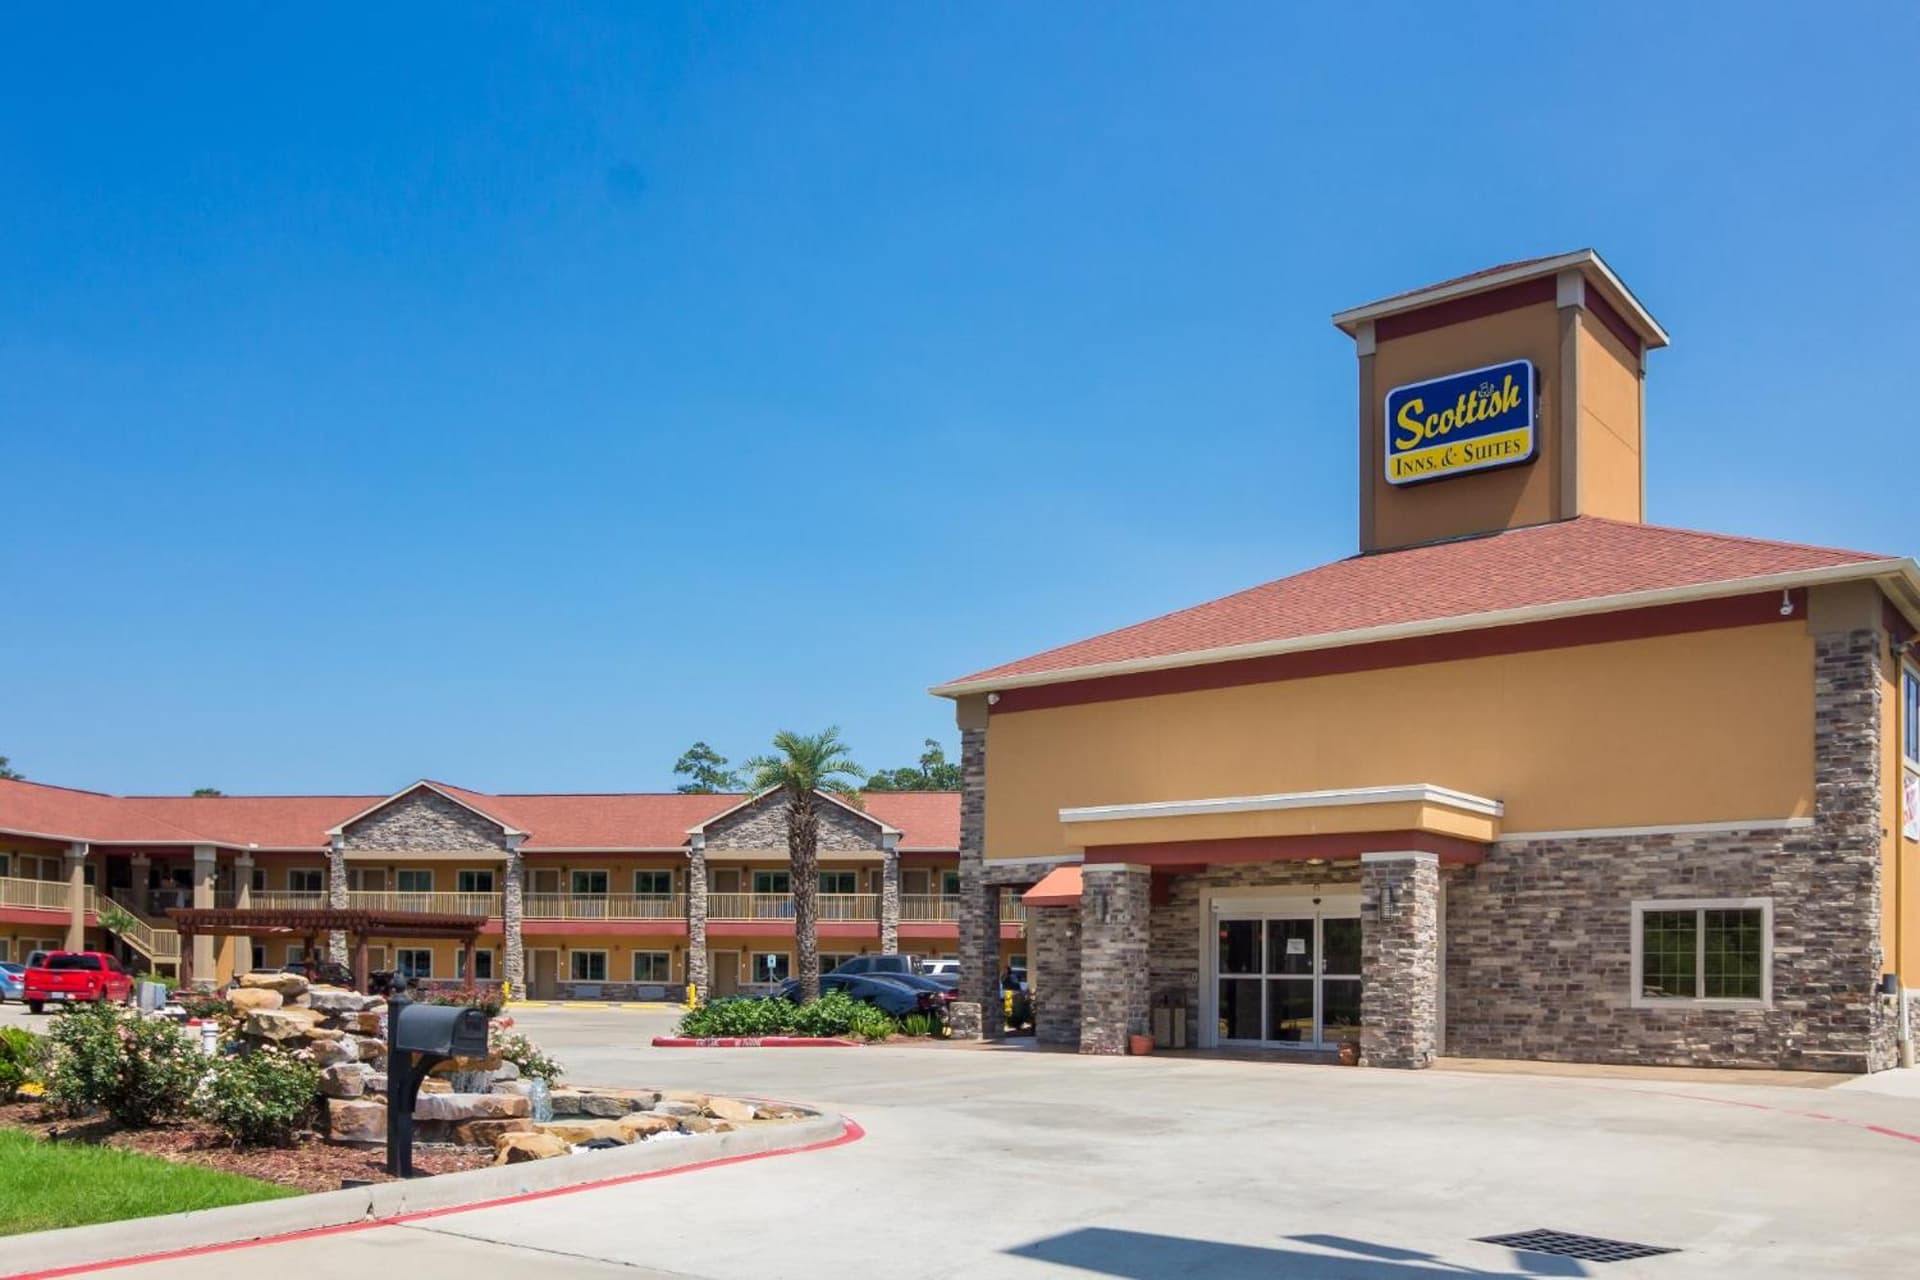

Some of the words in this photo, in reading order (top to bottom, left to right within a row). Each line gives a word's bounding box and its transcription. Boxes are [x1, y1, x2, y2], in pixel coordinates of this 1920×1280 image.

[1395, 374, 1522, 450] Scottish
[1441, 447, 1457, 466] &
[1463, 439, 1521, 463] SUITES
